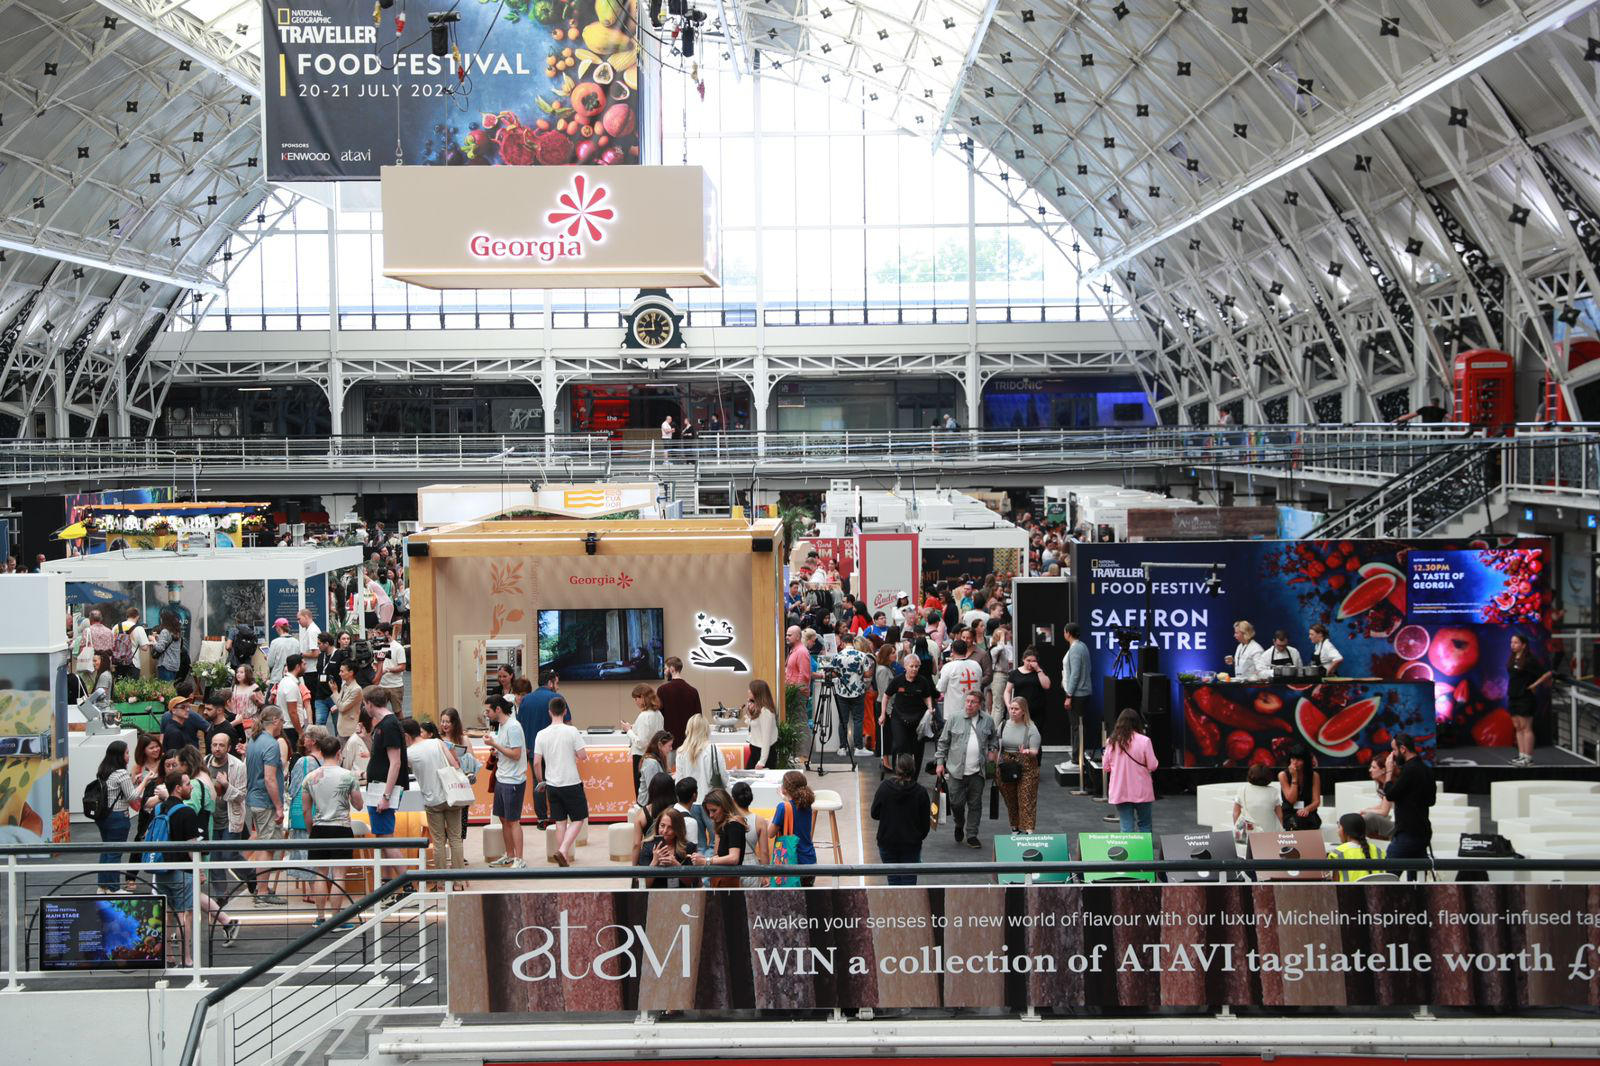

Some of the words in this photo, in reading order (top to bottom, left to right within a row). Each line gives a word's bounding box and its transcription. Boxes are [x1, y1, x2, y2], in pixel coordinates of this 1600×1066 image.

[278, 26, 376, 44] TRAVELLER
[298, 53, 382, 75] FOOD
[393, 53, 530, 76] FESTIVAL
[299, 84, 349, 97] 20-21
[358, 84, 402, 97] JULY
[281, 152, 330, 160] KENWOOD
[340, 148, 371, 162] atavi
[470, 234, 582, 262] Georgia
[994, 380, 1042, 390] TRIDONIC
[569, 575, 616, 586] Georgia
[1091, 568, 1144, 578] TRAVELLER
[1101, 582, 1146, 594] FOOD
[1091, 609, 1208, 627] SAFFRON
[753, 915, 818, 929] Awaken
[824, 916, 861, 932] your
[866, 916, 926, 928] senses
[931, 914, 948, 928] to
[954, 916, 963, 927] a
[969, 915, 1003, 927] new
[1008, 912, 1055, 927] world
[1061, 912, 1079, 926] of
[1082, 912, 1141, 926] flavour
[1146, 911, 1181, 926] with
[1187, 913, 1216, 925] our
[1221, 911, 1272, 928] luxury
[1277, 910, 1432, 928] Michelin-inspired,
[1438, 910, 1571, 925] flavour-infused
[512, 904, 699, 981] atavi
[754, 946, 837, 976] WIN
[849, 955, 869, 974] a
[880, 945, 1057, 974] collection
[1068, 944, 1107, 973] of
[1117, 944, 1235, 972] ATAVI
[1246, 943, 1432, 981] tagliatelle
[1443, 943, 1555, 972] worth
